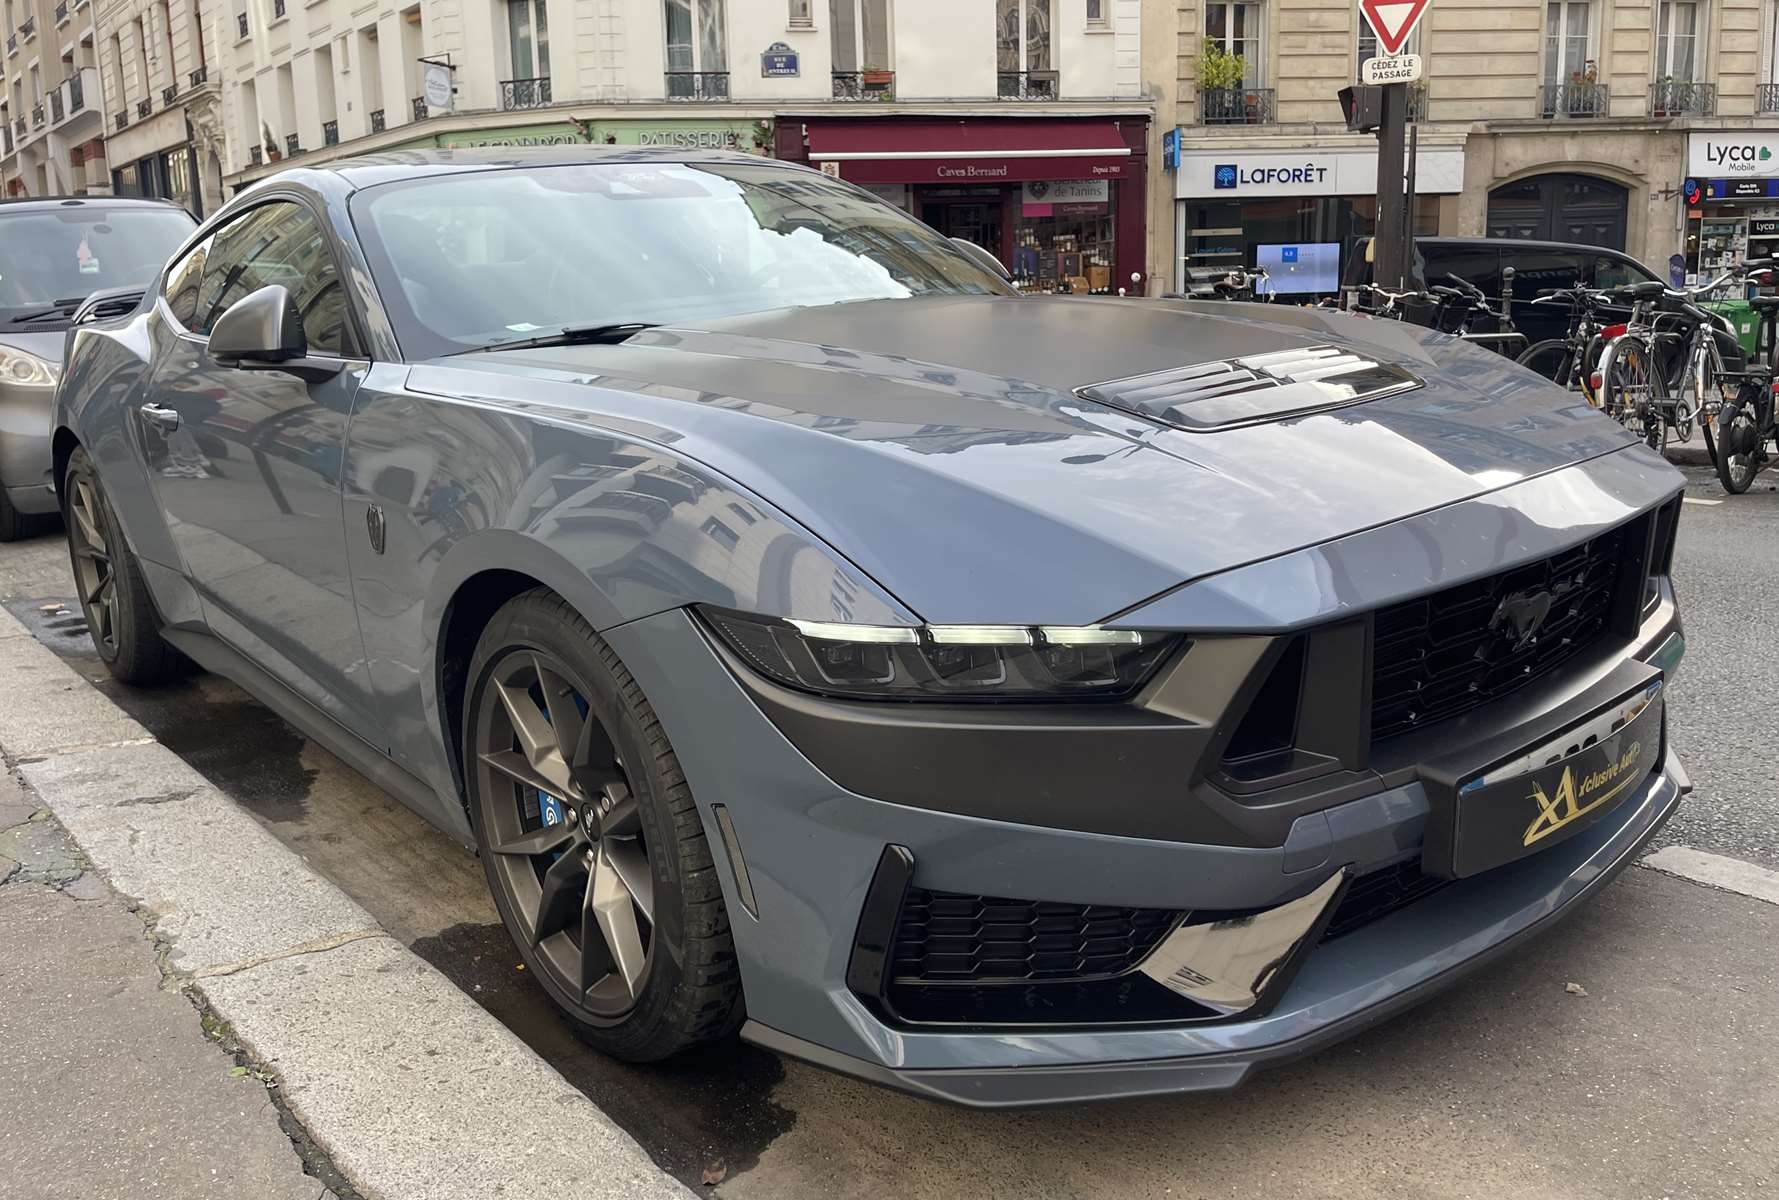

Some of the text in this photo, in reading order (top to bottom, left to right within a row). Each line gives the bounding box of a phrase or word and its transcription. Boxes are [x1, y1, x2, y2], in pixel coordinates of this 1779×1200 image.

[1371, 59, 1414, 70] CÉDEZ LE
[1372, 69, 1413, 80] PASSAGE
[1707, 142, 1756, 165] Lyca
[937, 165, 1008, 177] Caves Bernard
[1728, 163, 1756, 171] Mobile
[1055, 186, 1102, 197] de Tanins
[1756, 222, 1775, 232] Lyca
